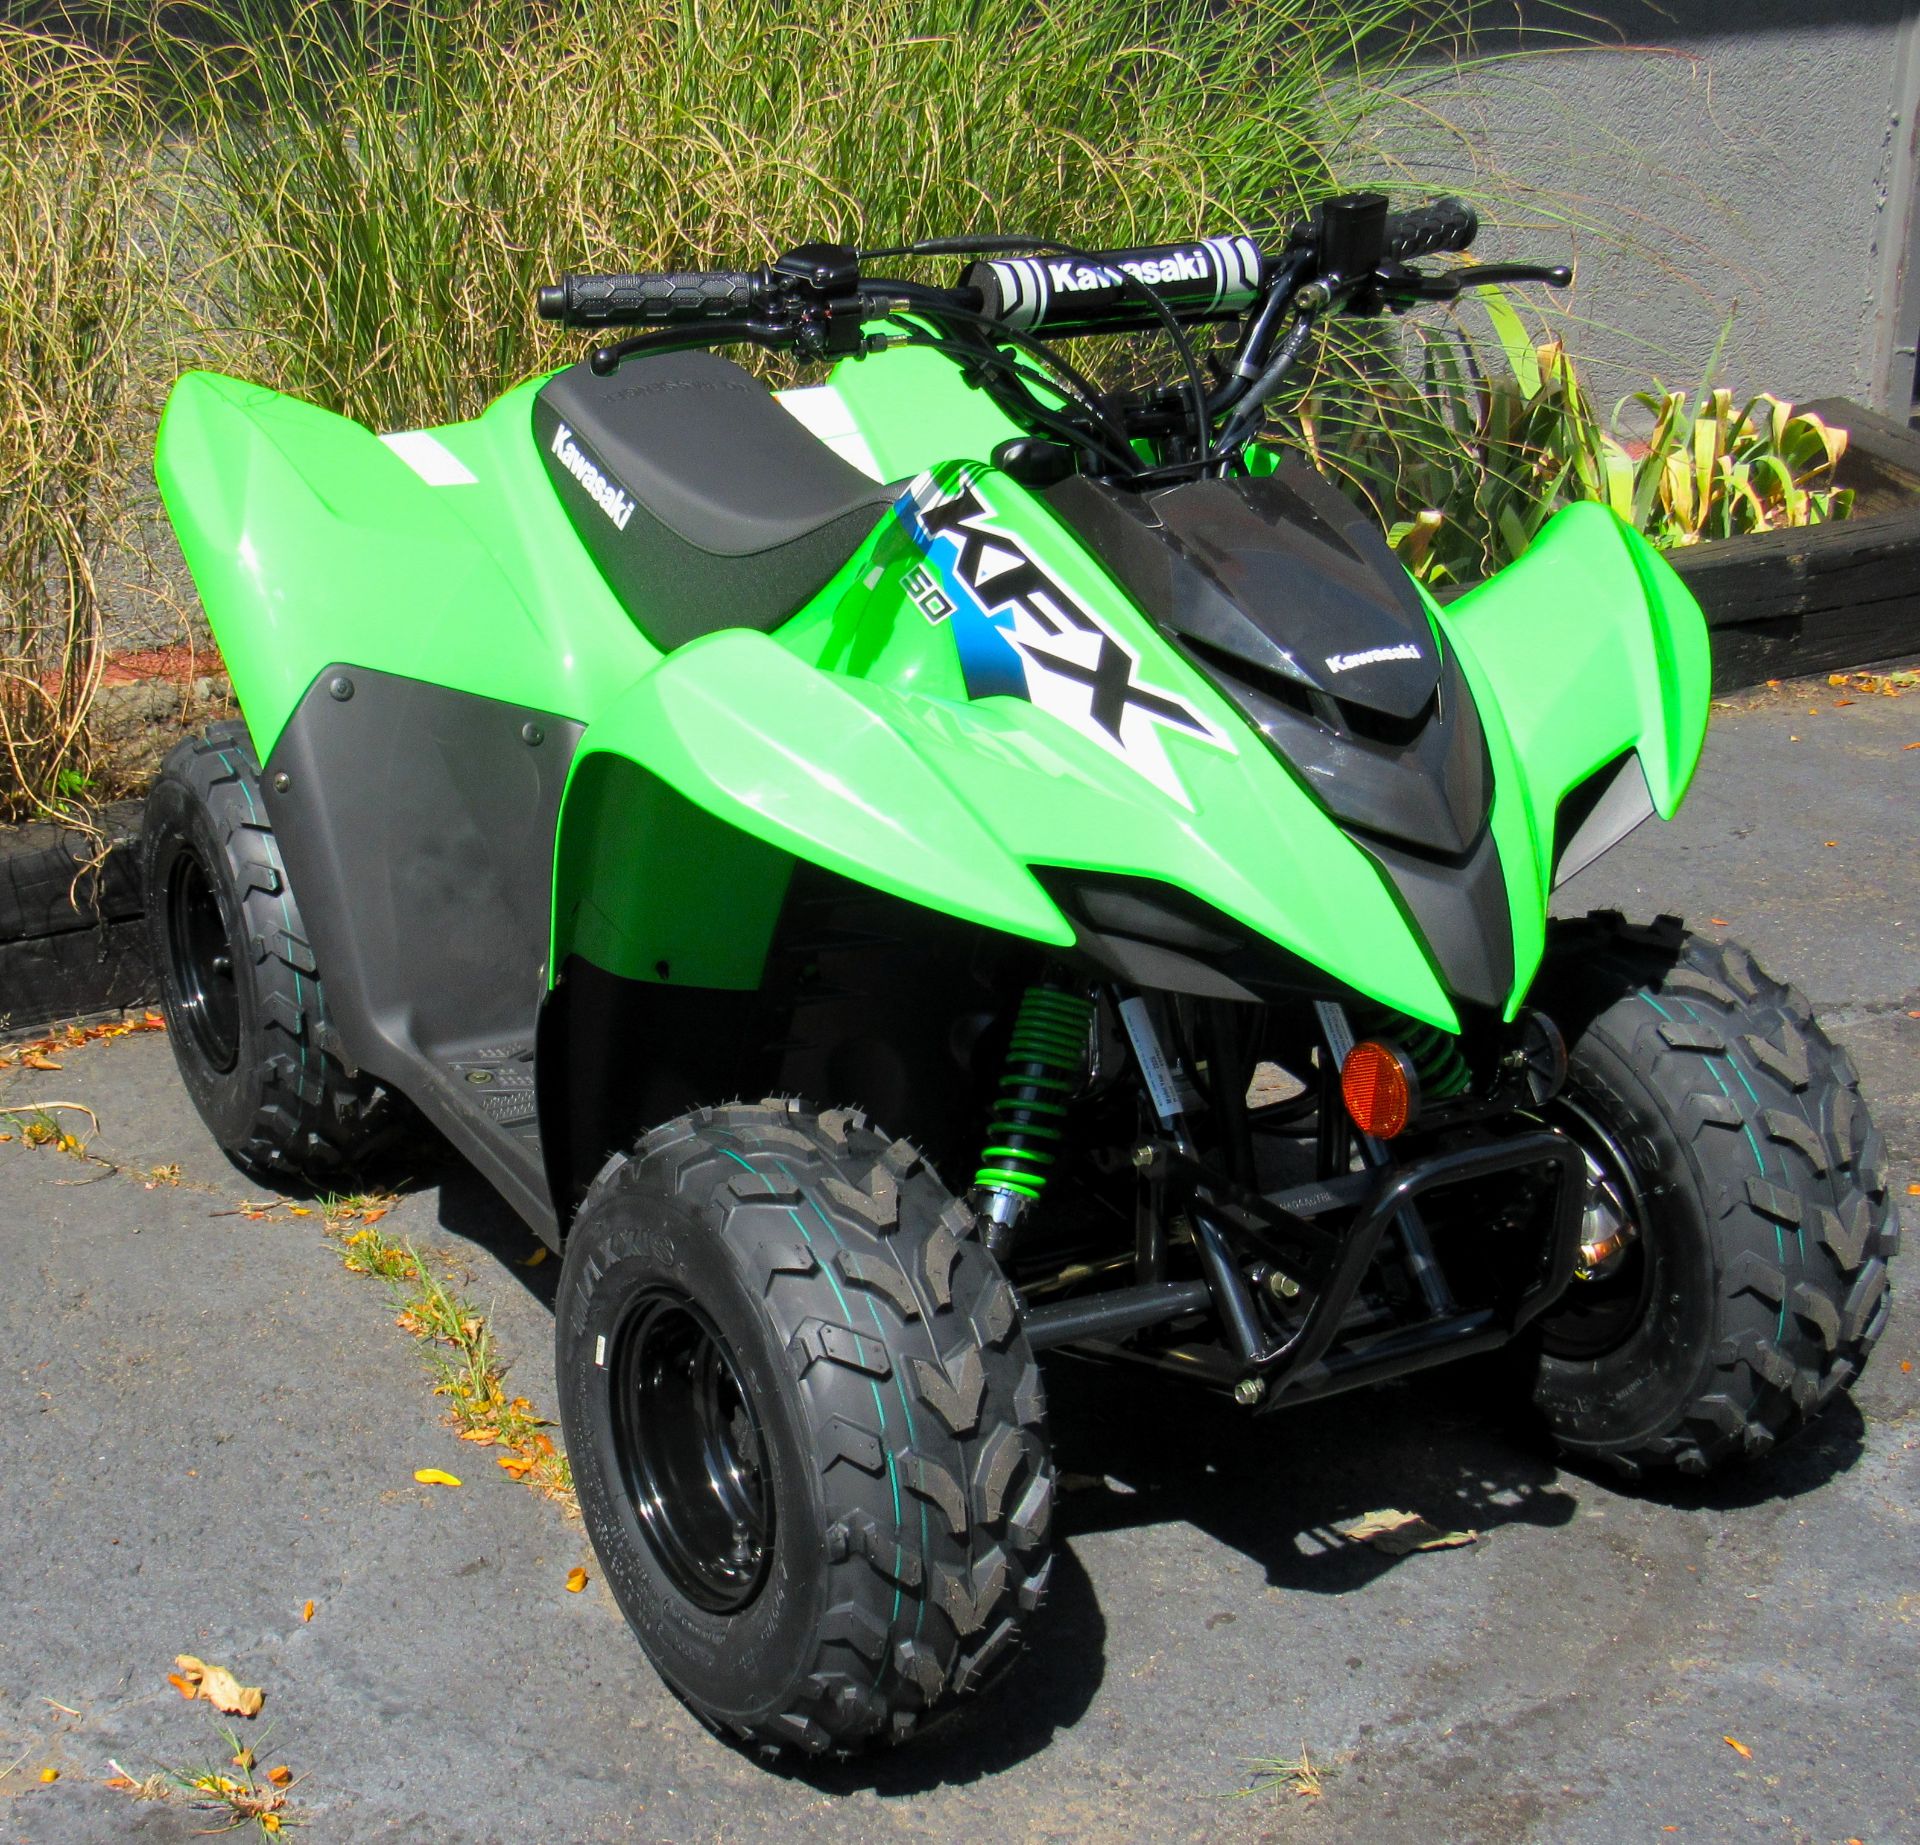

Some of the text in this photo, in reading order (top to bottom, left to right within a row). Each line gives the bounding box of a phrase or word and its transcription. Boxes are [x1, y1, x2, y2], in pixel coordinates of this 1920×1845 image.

[551, 423, 636, 531] Kawasaki
[899, 563, 957, 626] 50
[919, 484, 1217, 751] KFX
[1325, 644, 1421, 674] Kawasaki
